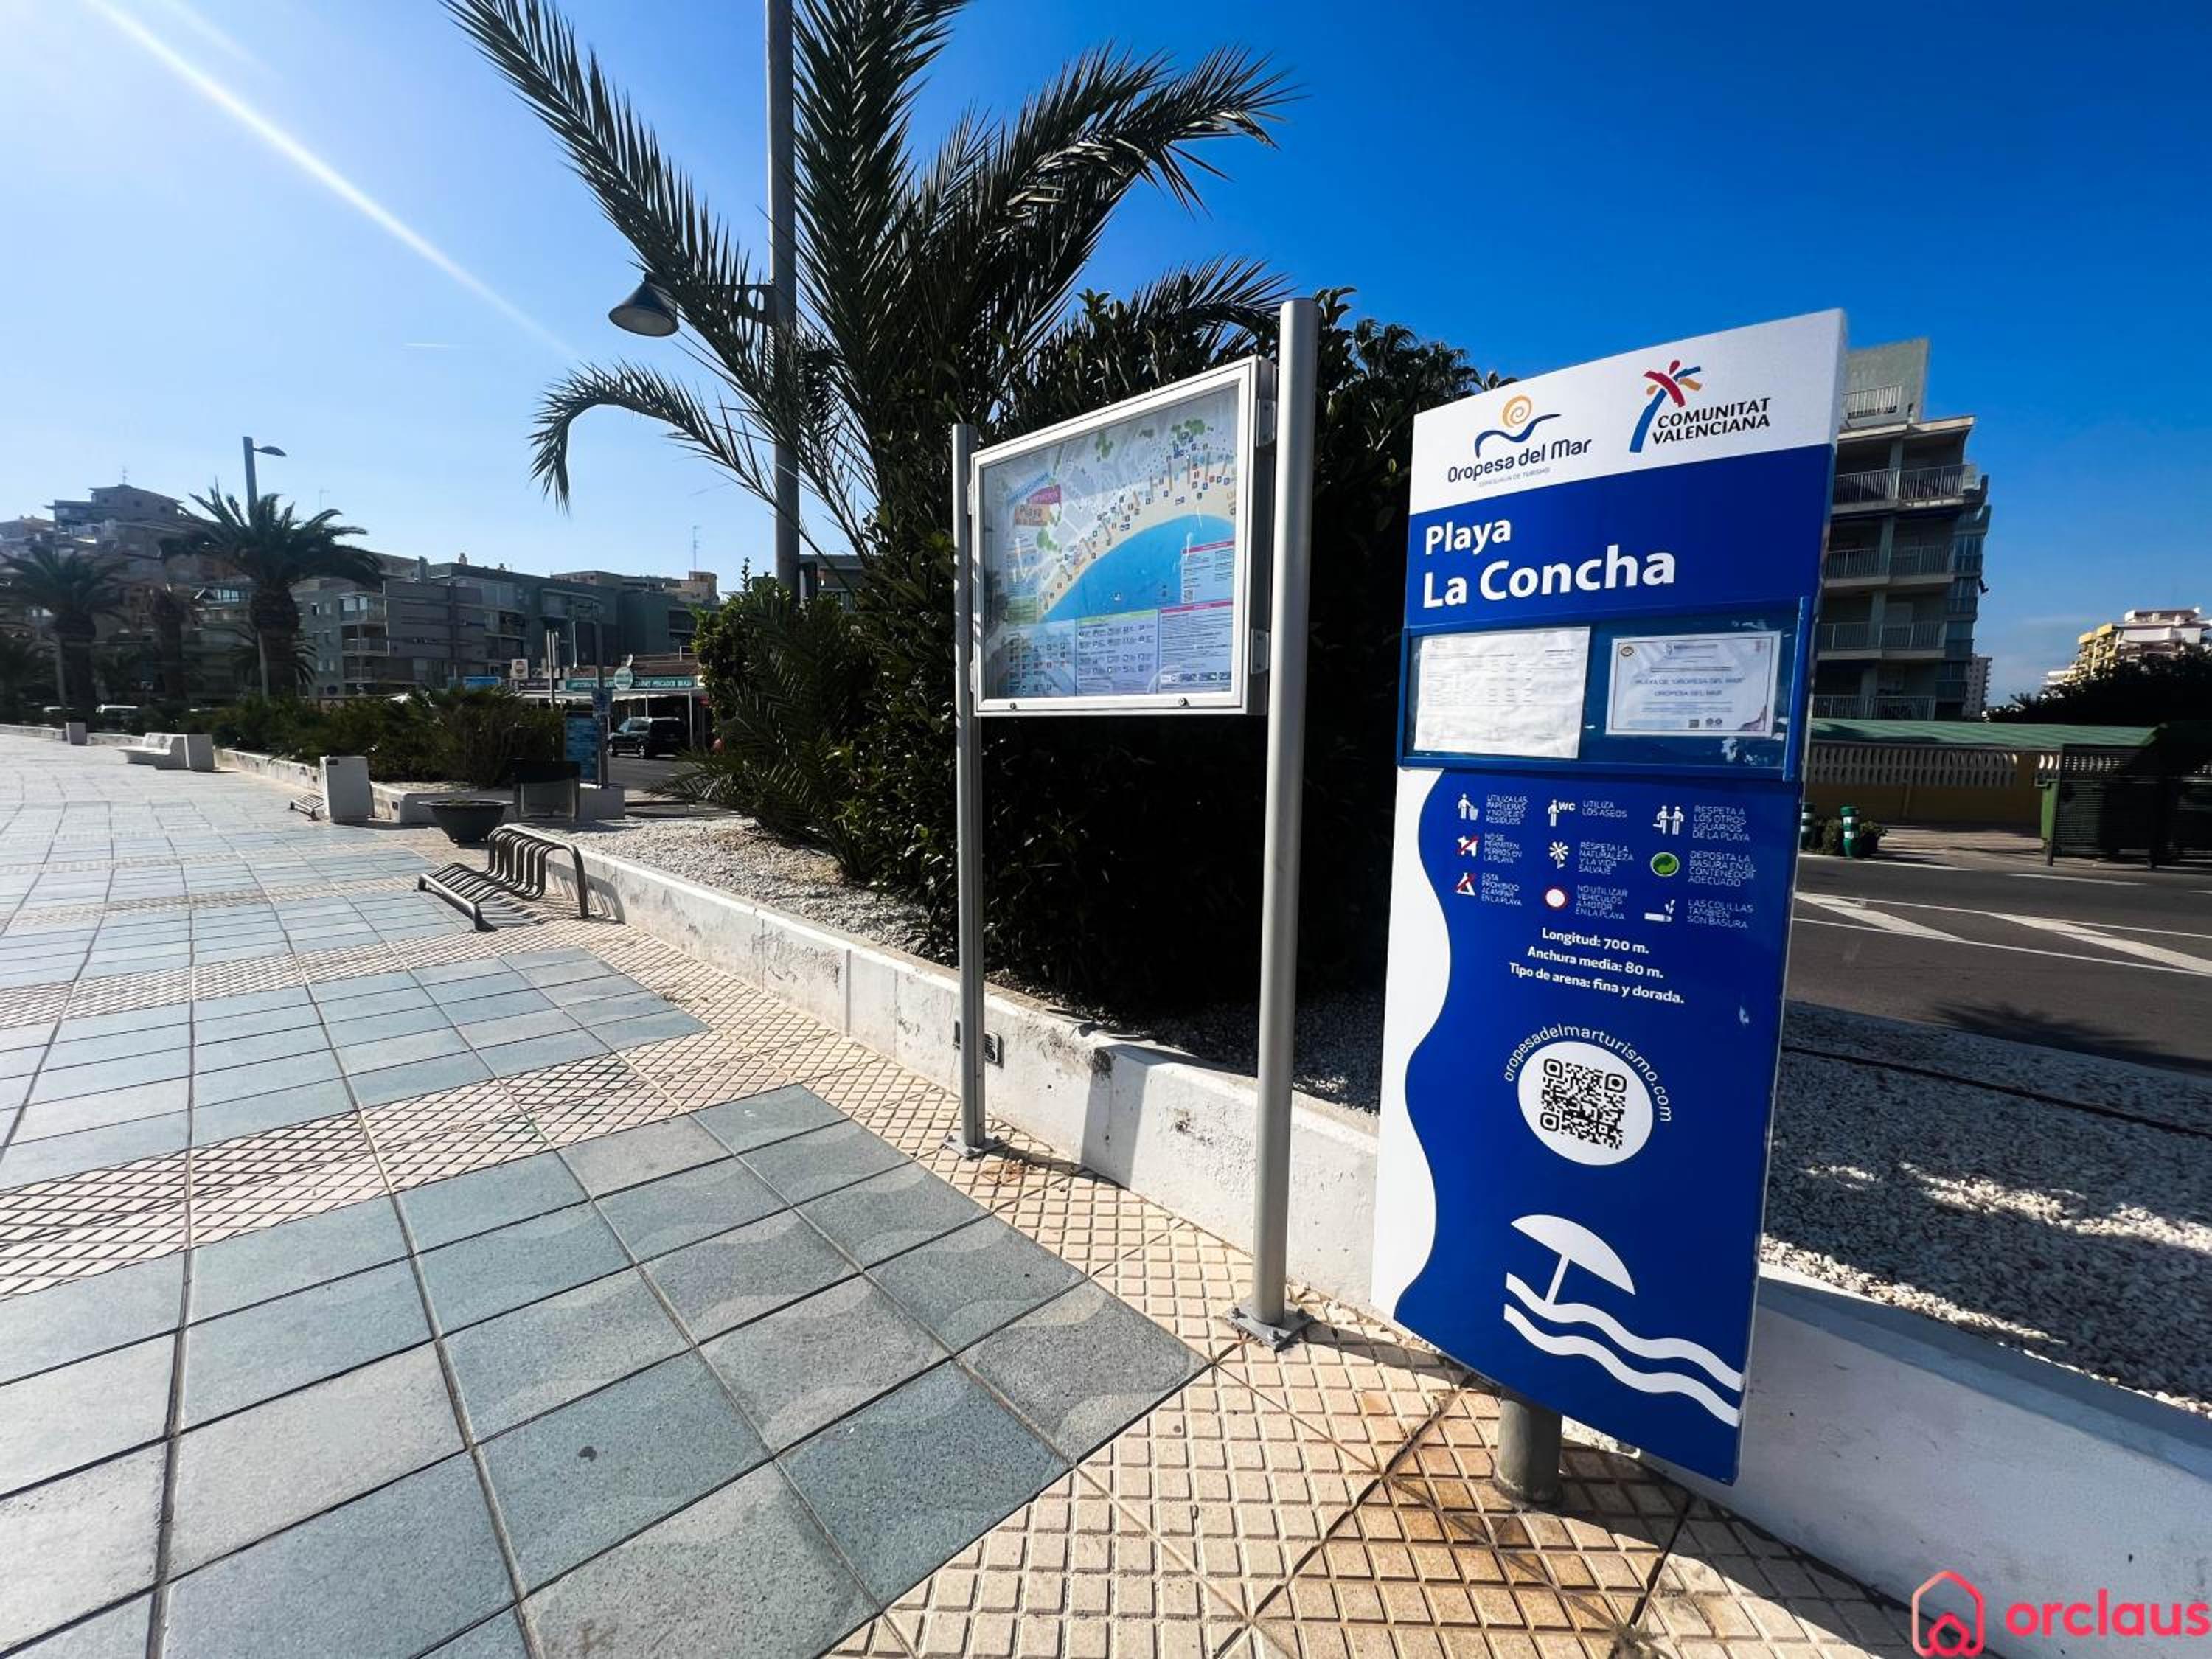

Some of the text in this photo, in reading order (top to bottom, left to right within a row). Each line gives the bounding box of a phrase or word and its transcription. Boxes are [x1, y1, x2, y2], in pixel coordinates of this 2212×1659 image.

[1658, 397, 1770, 428] COMUNITAT
[1652, 414, 1770, 445] VALENCIANA
[1448, 456, 1514, 483] Oropesa
[1518, 444, 1546, 467] del
[1551, 439, 1592, 459] Mar
[1425, 519, 1512, 556] Playa
[1423, 544, 1676, 609] La Concha
[1558, 802, 1576, 811] WC
[1583, 800, 1615, 809] UTILIZA
[1694, 805, 1737, 815] RESPETA
[1582, 808, 1628, 818] LOS ASEOS
[1694, 814, 1747, 825] LOS OTROS
[1693, 822, 1742, 833] USUARIOS
[1693, 830, 1750, 841] DE LA PLAYA
[1580, 841, 1629, 853] RESPETA LA
[1690, 850, 1750, 863] DEPOSITA LA
[1689, 859, 1728, 869] BASURA
[1688, 875, 1741, 887] ADECUADO
[1688, 900, 1707, 908] LAS
[1708, 917, 1748, 928] BASURA
[1542, 927, 1649, 954] Longitud: 700 m.
[1528, 946, 1664, 978] Anchura media: 80 m.
[1509, 962, 1686, 1004] Tipo de arena: fina y dorada.
[1503, 1023, 1672, 1122] oropesadelmarturismo.com
